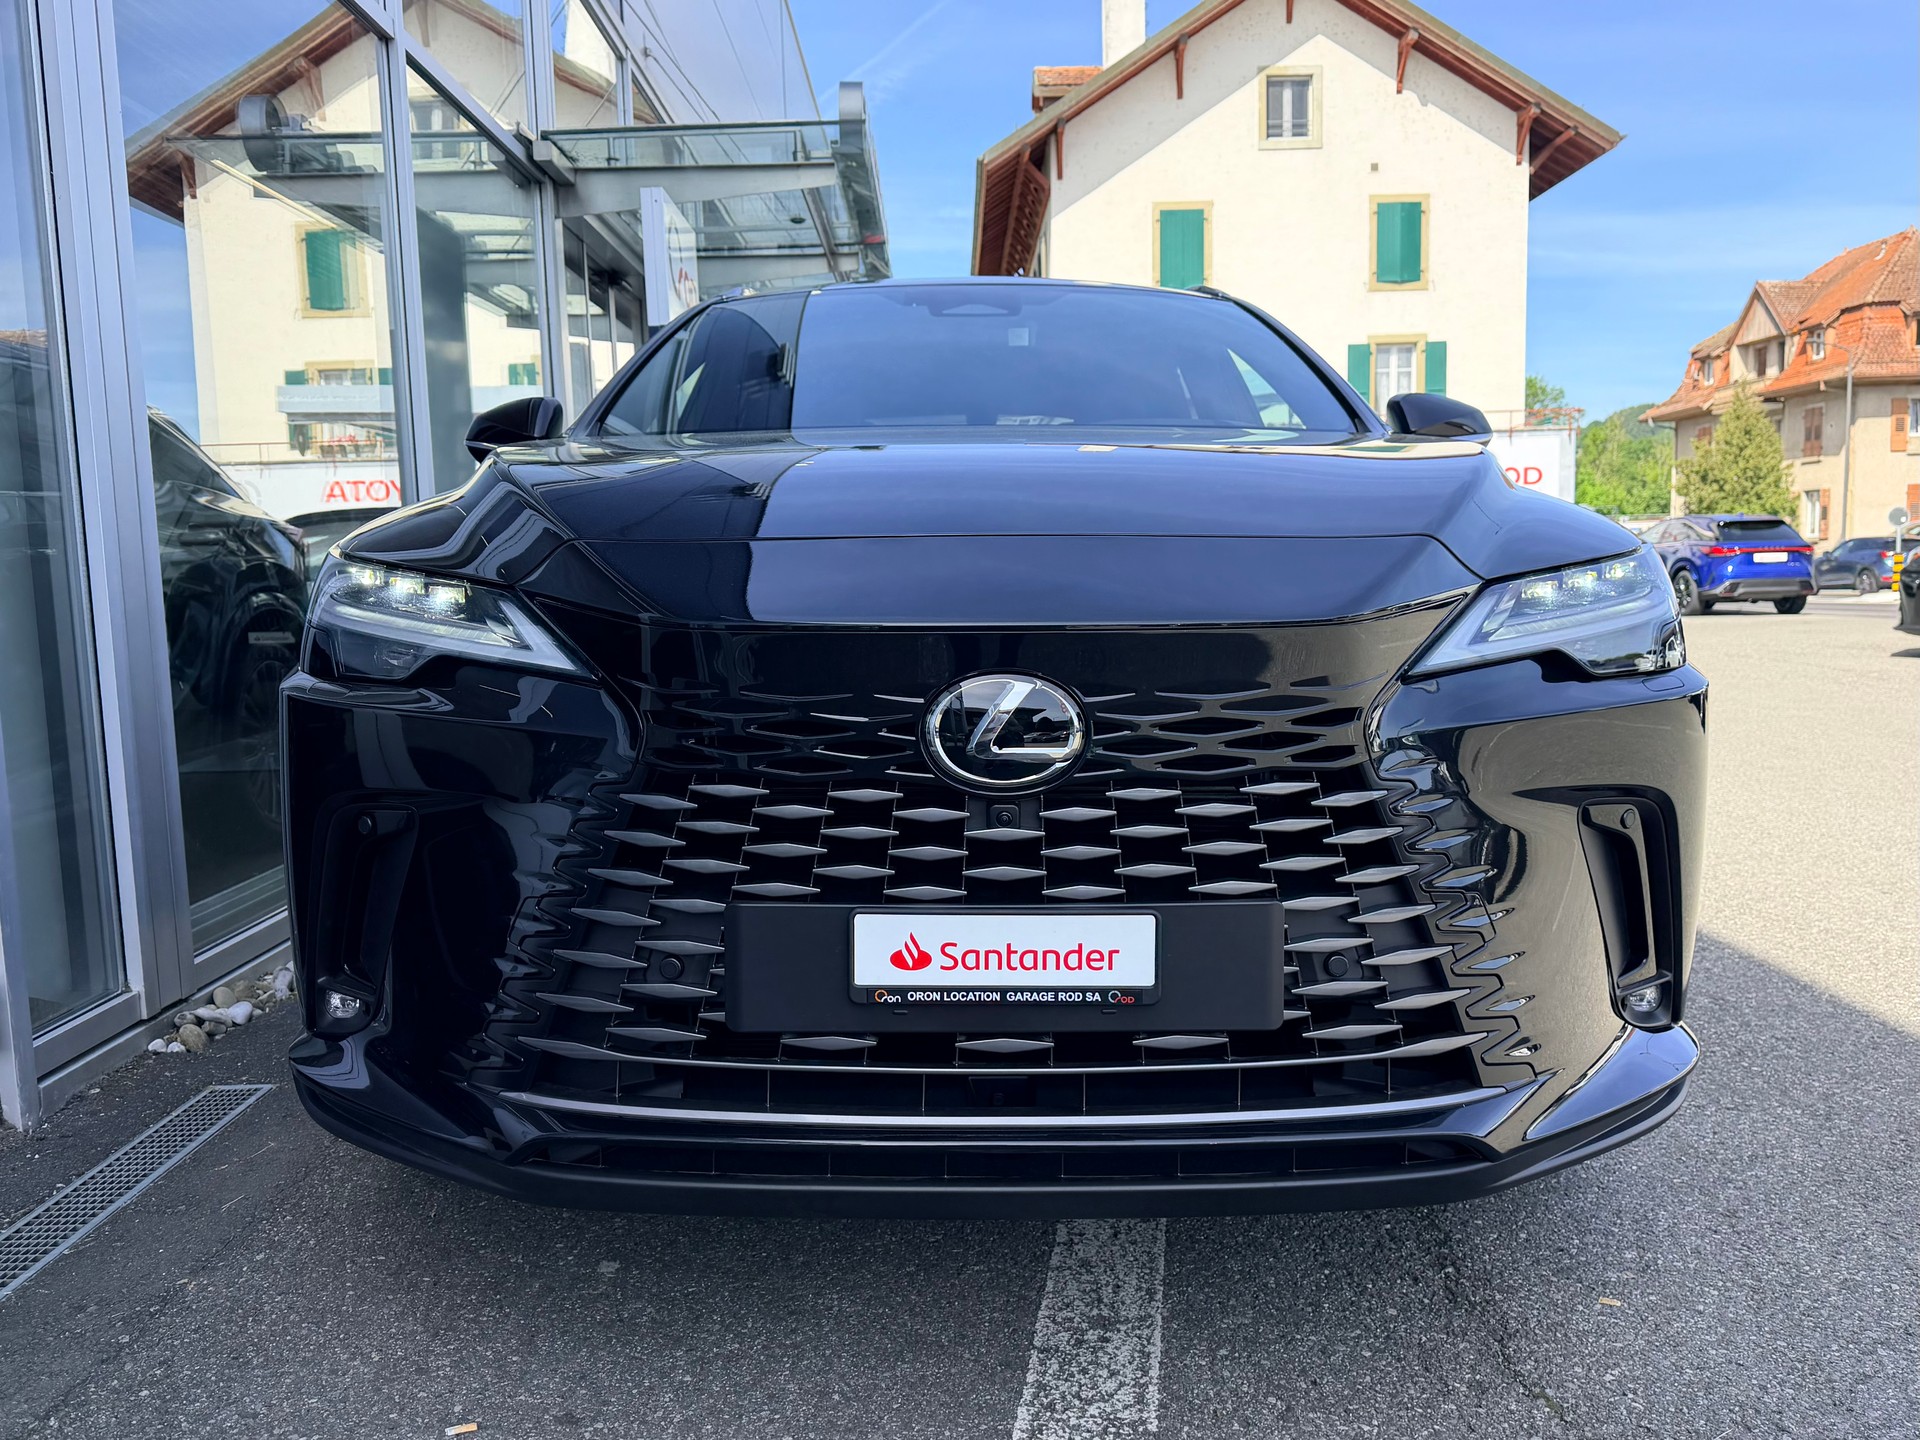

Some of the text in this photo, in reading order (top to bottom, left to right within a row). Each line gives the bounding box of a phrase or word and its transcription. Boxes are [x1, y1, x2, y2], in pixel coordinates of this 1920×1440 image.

[940, 942, 1120, 971] Santander
[907, 991, 1102, 1002] ORON LOCATION GARAGE ROD SA
